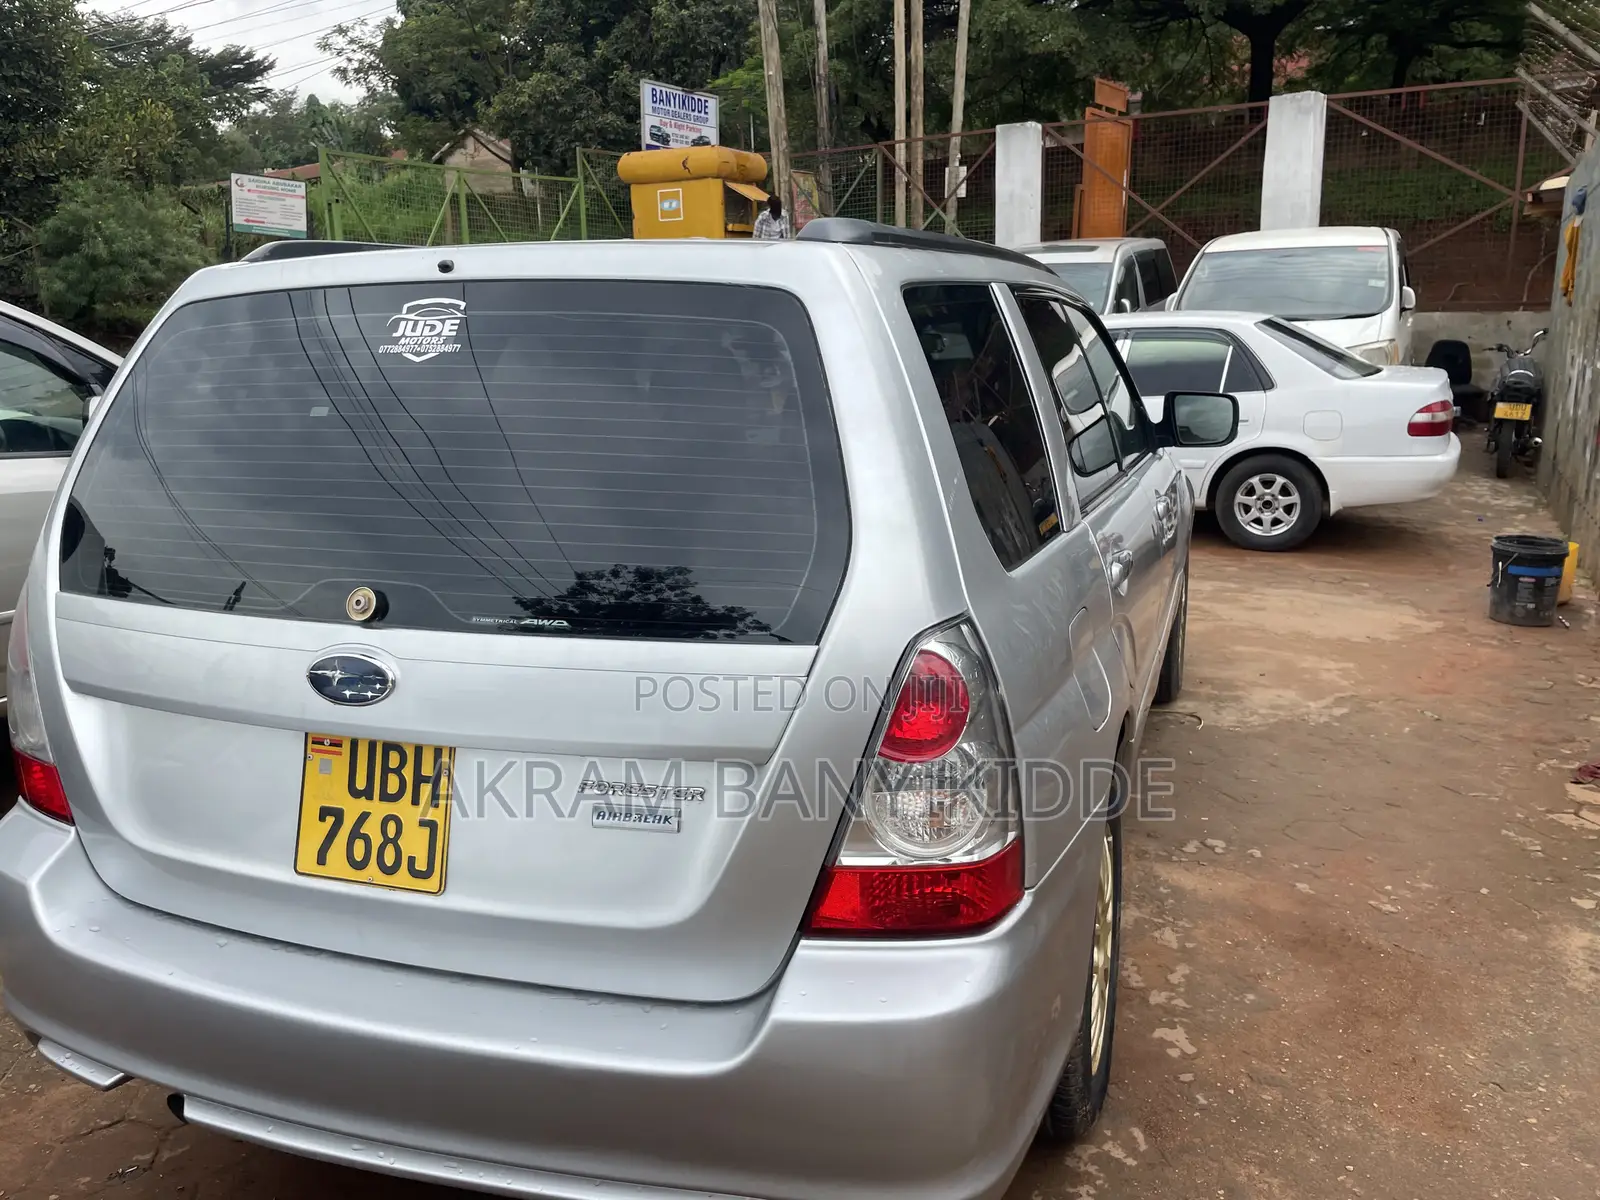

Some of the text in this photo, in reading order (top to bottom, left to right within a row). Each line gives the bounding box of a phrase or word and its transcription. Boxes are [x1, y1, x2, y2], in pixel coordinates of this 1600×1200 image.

[652, 88, 709, 115] BANYIKIDDE
[652, 106, 709, 124] MOTOR DEALERS GROUP
[391, 319, 461, 337] JUDE
[398, 336, 447, 345] MOTORS
[472, 616, 570, 627] SYMMETRICAL AWD
[347, 738, 444, 809] UBH
[577, 779, 706, 802] FORESTER
[595, 810, 674, 825] AIRBREAK
[316, 805, 439, 880] 768J
